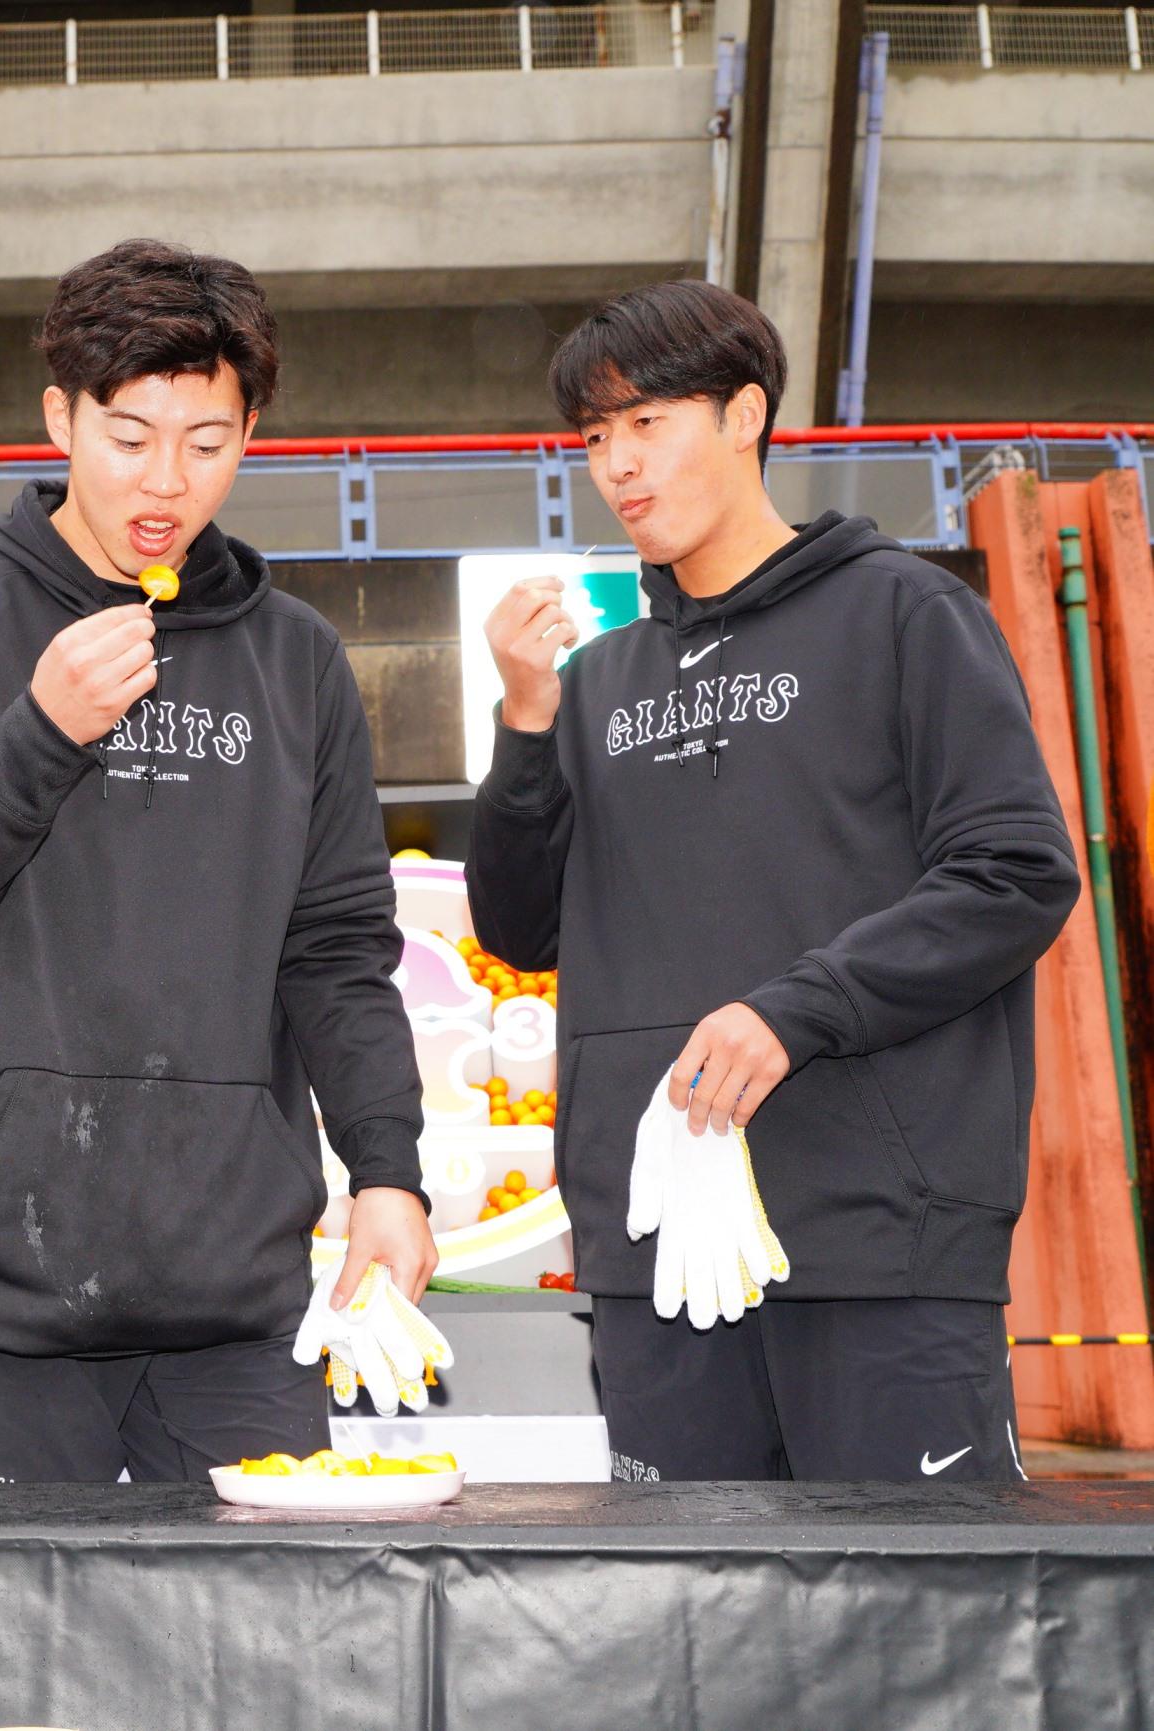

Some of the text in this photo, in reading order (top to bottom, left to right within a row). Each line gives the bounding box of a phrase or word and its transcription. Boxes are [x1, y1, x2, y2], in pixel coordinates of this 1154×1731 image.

[100, 698, 253, 764] ANTS
[606, 672, 800, 757] GIANTS
[654, 749, 691, 762] AUTHETIC
[683, 738, 704, 750] TOKYO
[507, 1005, 545, 1050] 3
